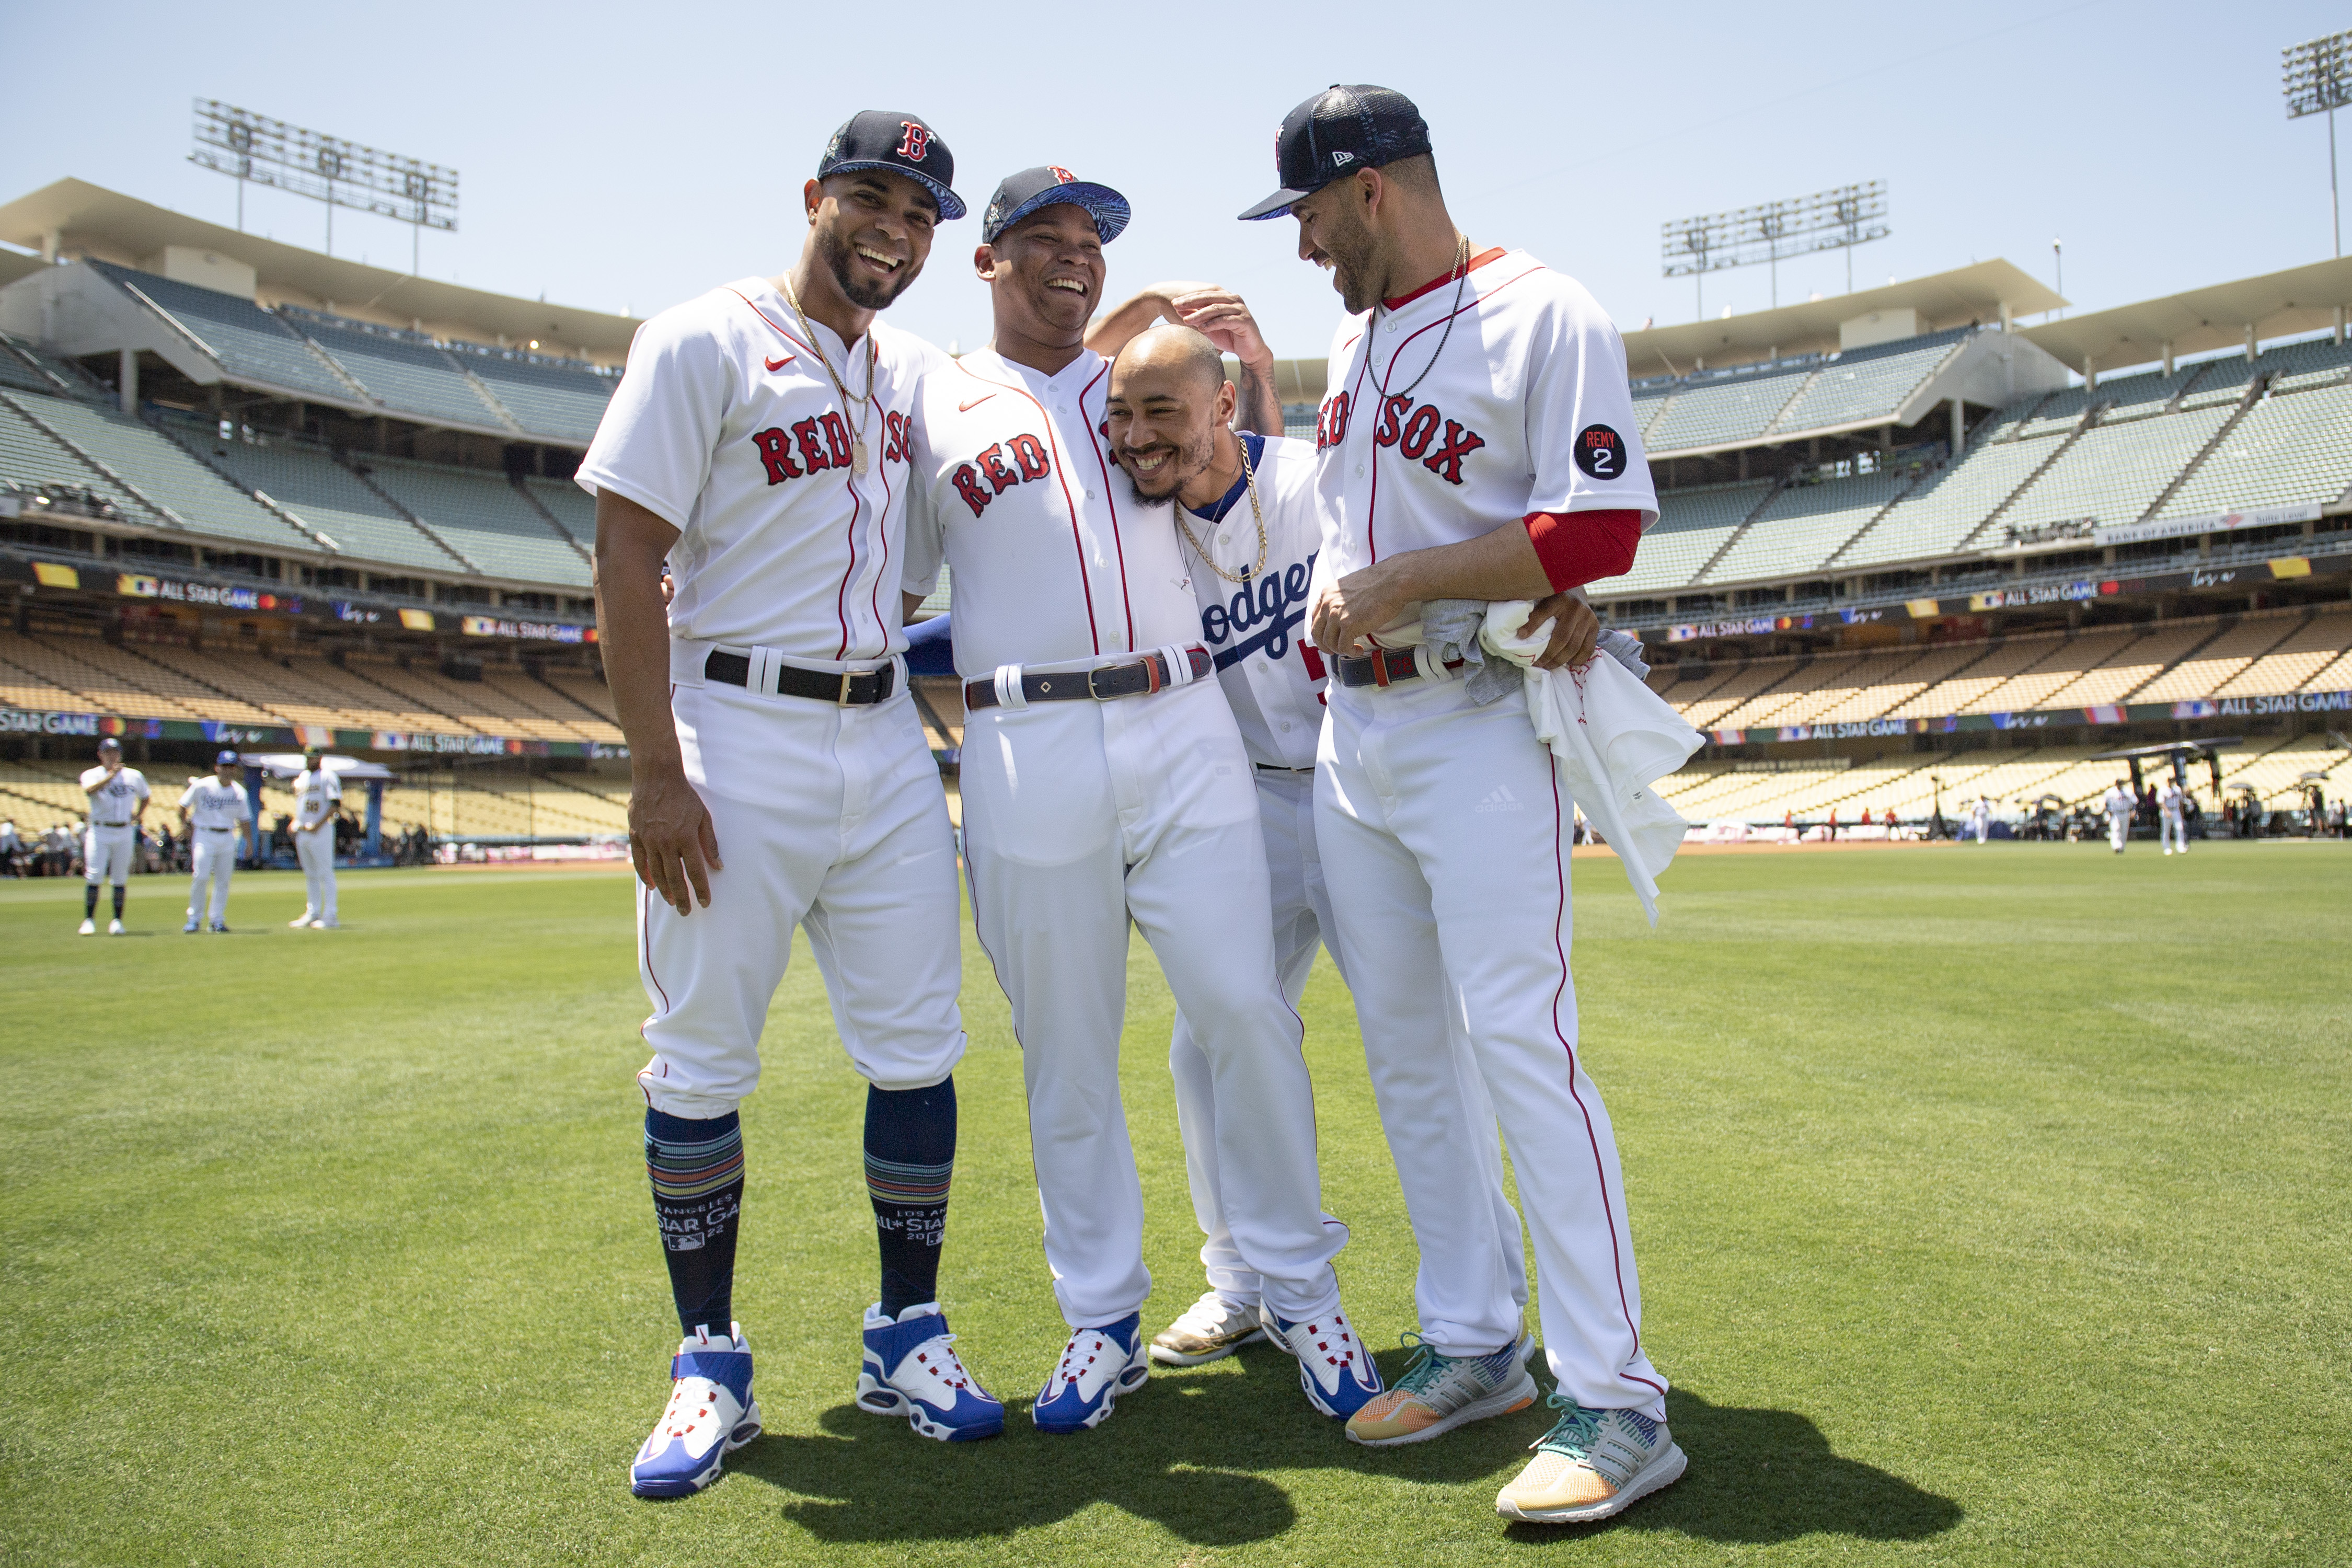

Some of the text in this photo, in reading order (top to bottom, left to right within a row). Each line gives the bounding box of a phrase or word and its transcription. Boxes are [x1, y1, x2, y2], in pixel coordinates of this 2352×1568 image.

[897, 121, 929, 162] B
[752, 411, 852, 486] RED
[1316, 390, 1485, 485] ED SOX
[1586, 432, 1615, 448] REMY
[1594, 448, 1613, 472] 2
[952, 433, 1051, 518] RED
[2107, 530, 2139, 542] BANK
[2161, 521, 2217, 536] AMERICA
[159, 580, 186, 601] ALL
[186, 582, 220, 605] STAR
[219, 586, 259, 609] GAME
[2005, 591, 2028, 607] ALL
[2028, 586, 2060, 604] STAR
[2059, 582, 2099, 601] GAME
[1190, 658, 1202, 673] 11
[1391, 657, 1413, 675] 28
[2221, 690, 2352, 716] ALL STAR GAME
[1813, 719, 1908, 740] ALL STAR GAME
[1475, 802, 1525, 813] adidas
